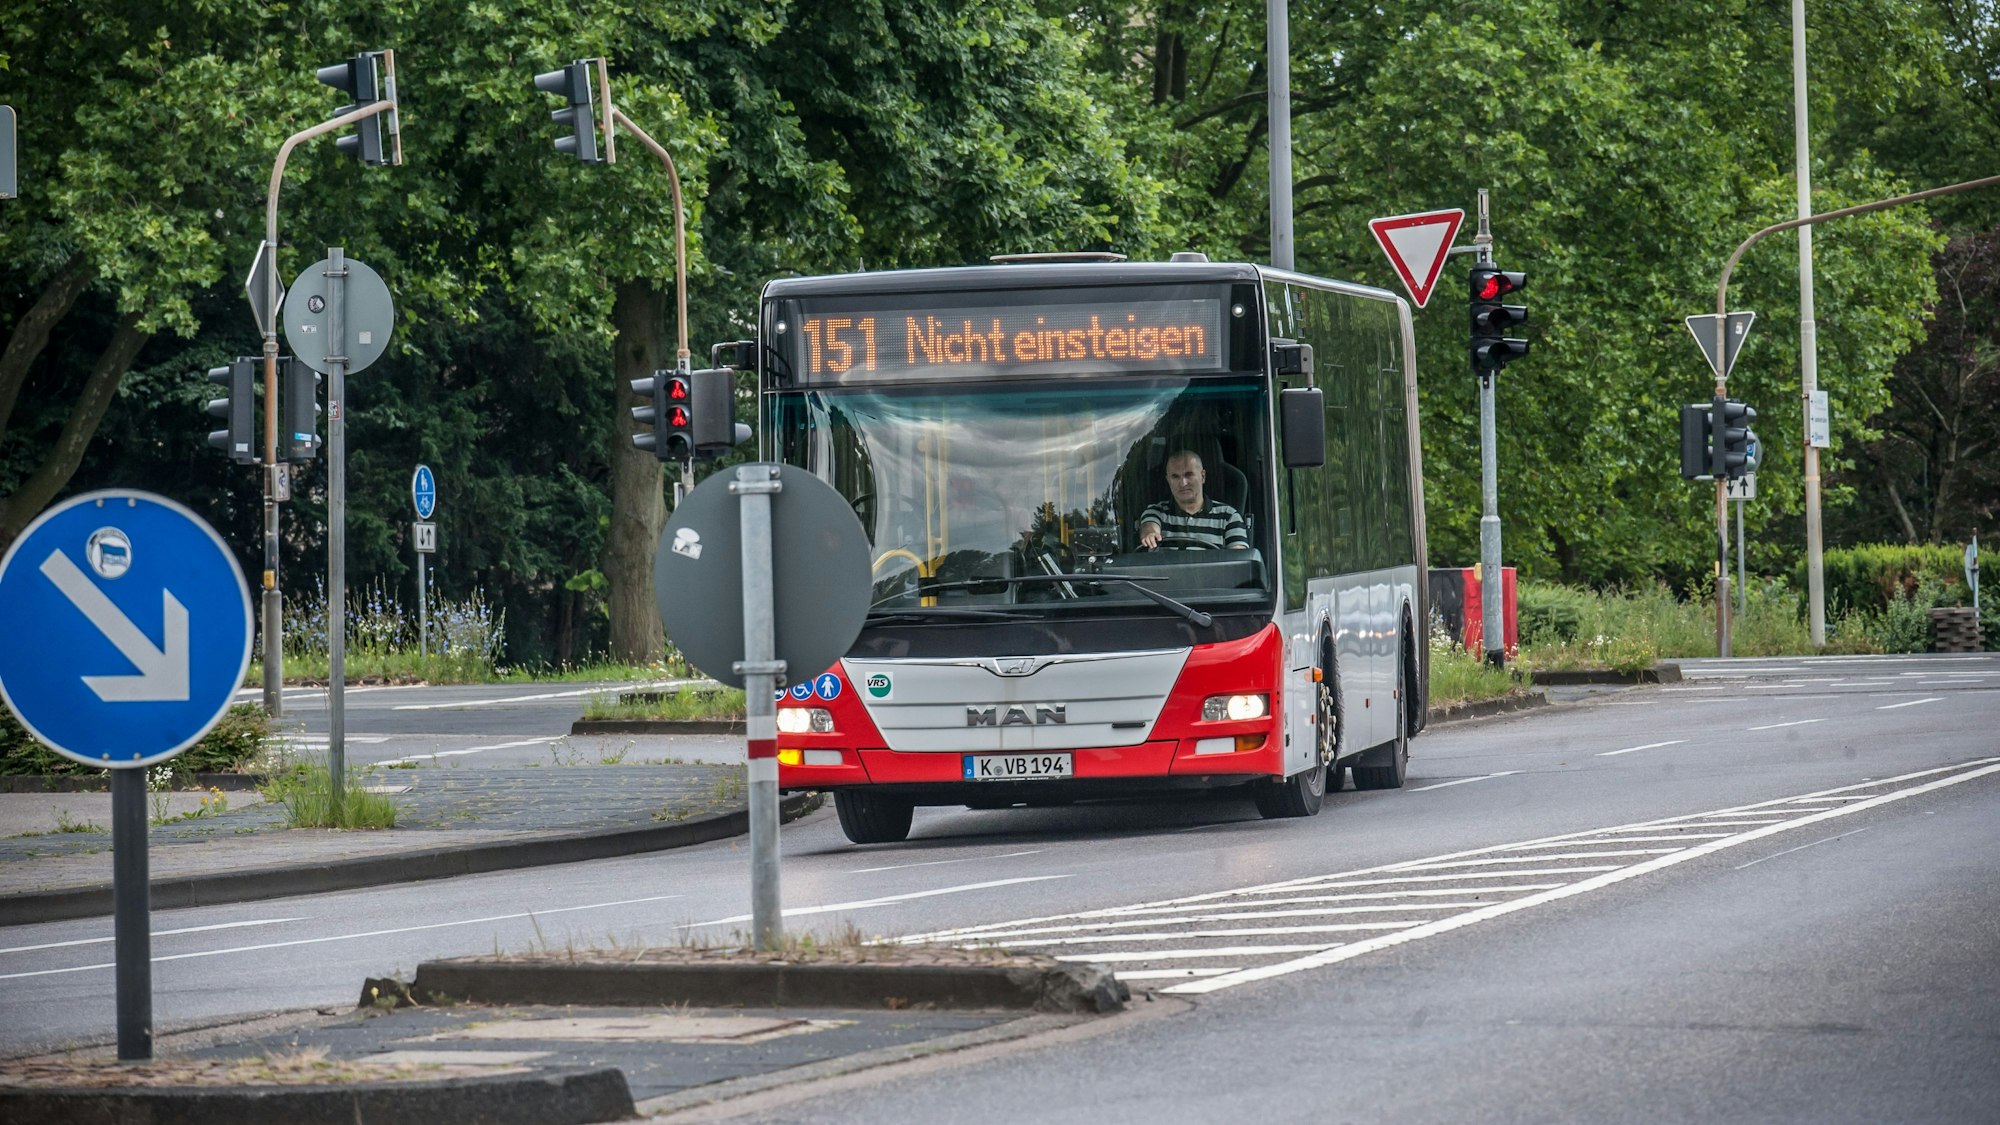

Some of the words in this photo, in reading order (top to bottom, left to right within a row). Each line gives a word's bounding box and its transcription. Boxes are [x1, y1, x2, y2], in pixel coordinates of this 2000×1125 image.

[803, 317, 876, 373] 151
[906, 316, 1006, 364] Nicht
[1014, 314, 1205, 361] einsteigen
[867, 678, 886, 688] VRS
[967, 704, 1066, 726] MAN
[1031, 757, 1064, 774] 194
